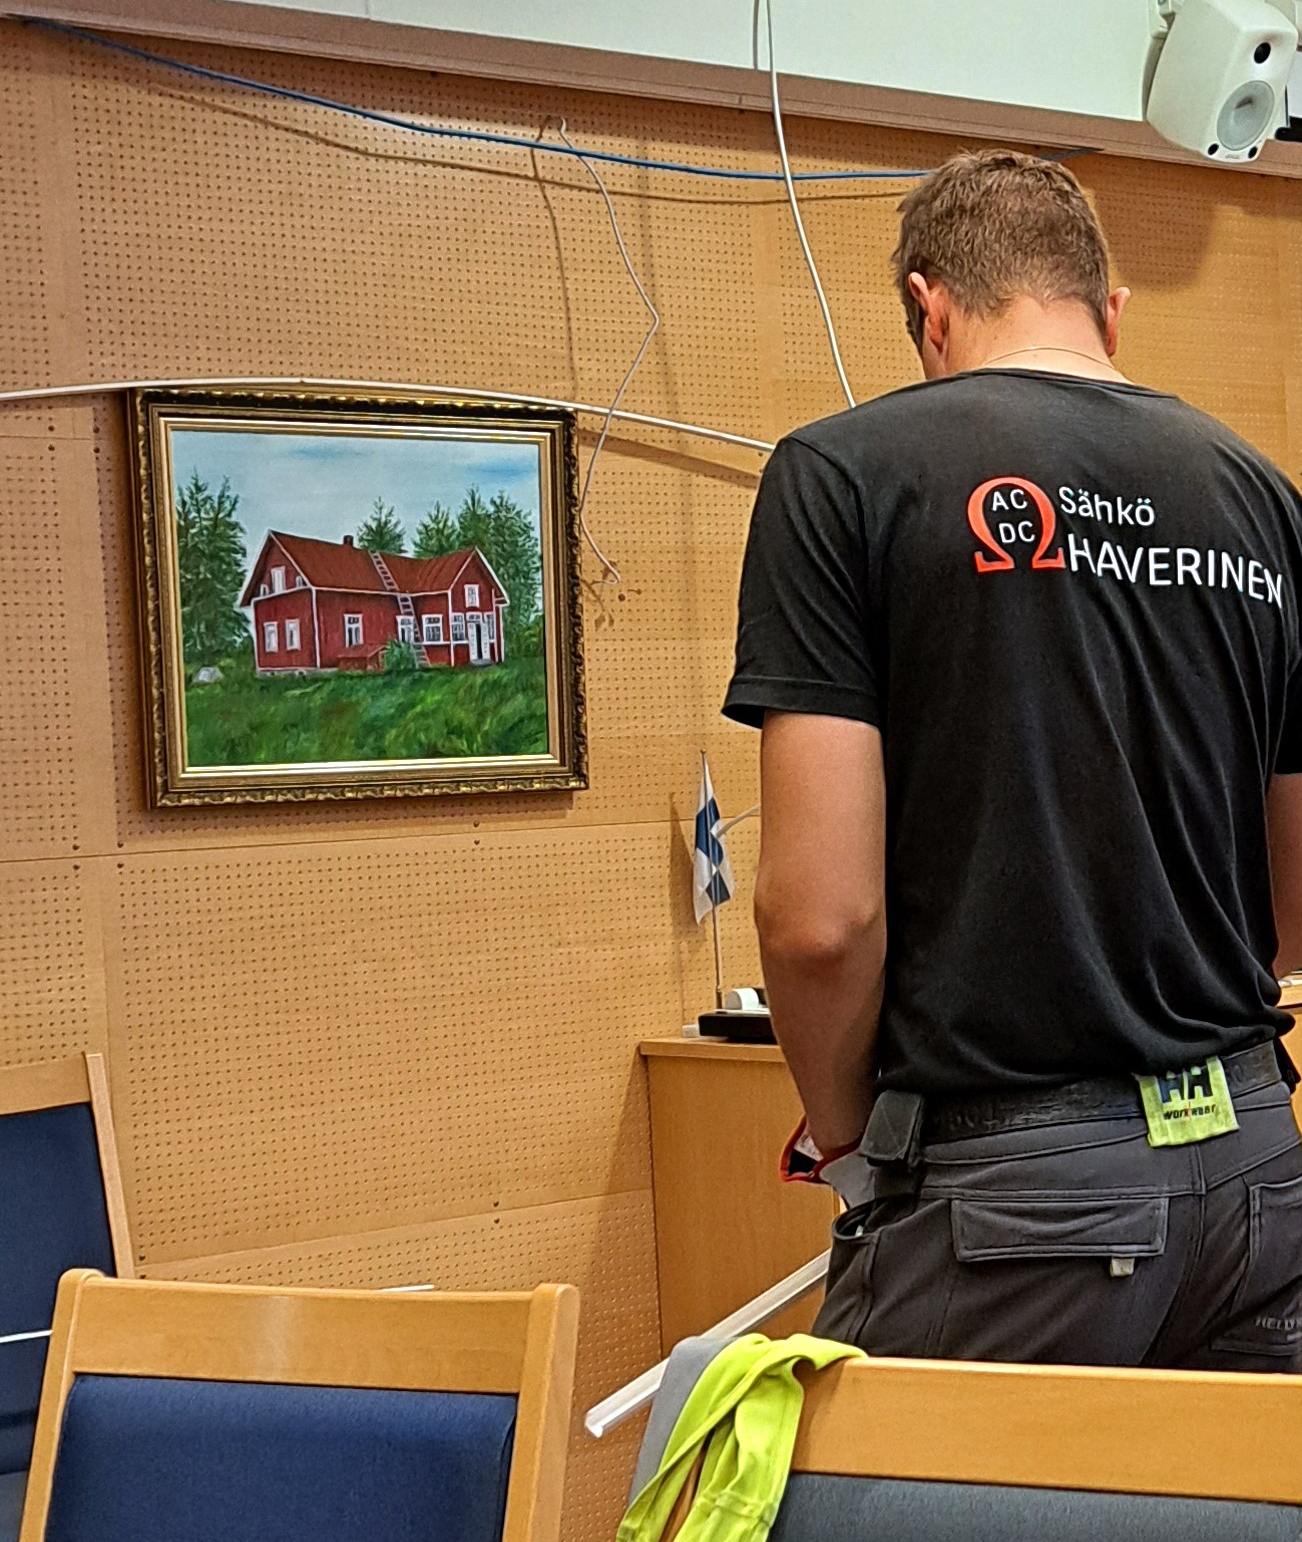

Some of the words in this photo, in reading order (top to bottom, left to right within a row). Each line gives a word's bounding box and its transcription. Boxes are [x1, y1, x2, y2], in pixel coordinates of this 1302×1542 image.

[991, 488, 1028, 512] AC
[1058, 486, 1155, 527] Sähkö
[999, 520, 1035, 544] DC
[1067, 532, 1284, 610] HAVERINEN
